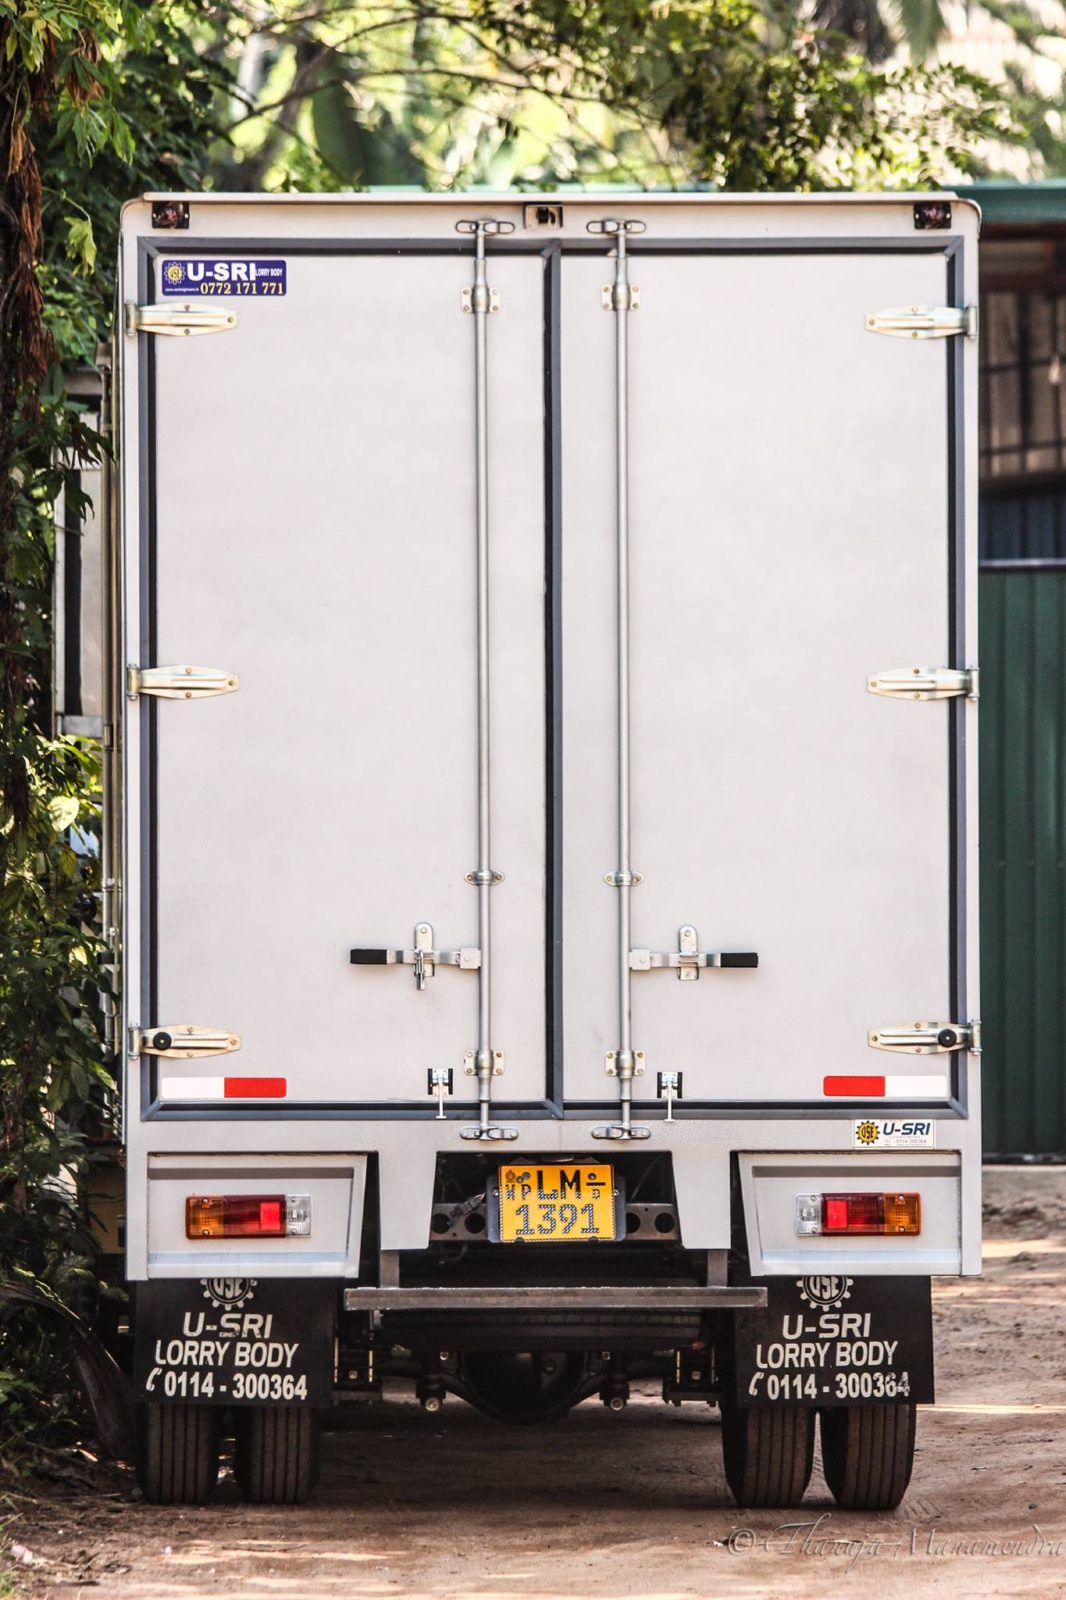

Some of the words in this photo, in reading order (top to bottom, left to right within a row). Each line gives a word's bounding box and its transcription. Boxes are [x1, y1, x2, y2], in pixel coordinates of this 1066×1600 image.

[187, 262, 256, 281] U-SRI
[200, 282, 231, 294] 0772
[236, 282, 257, 294] 171
[262, 282, 284, 294] 771
[883, 1123, 931, 1136] U-SRI
[515, 1204, 599, 1235] 1391
[183, 1312, 273, 1339] U-SRI
[782, 1313, 871, 1339] U-SRI
[155, 1339, 230, 1366] LORRY
[234, 1341, 299, 1368] BODY
[756, 1342, 830, 1369] LORRY
[835, 1340, 898, 1367] BODY
[232, 1373, 308, 1400] 300364
